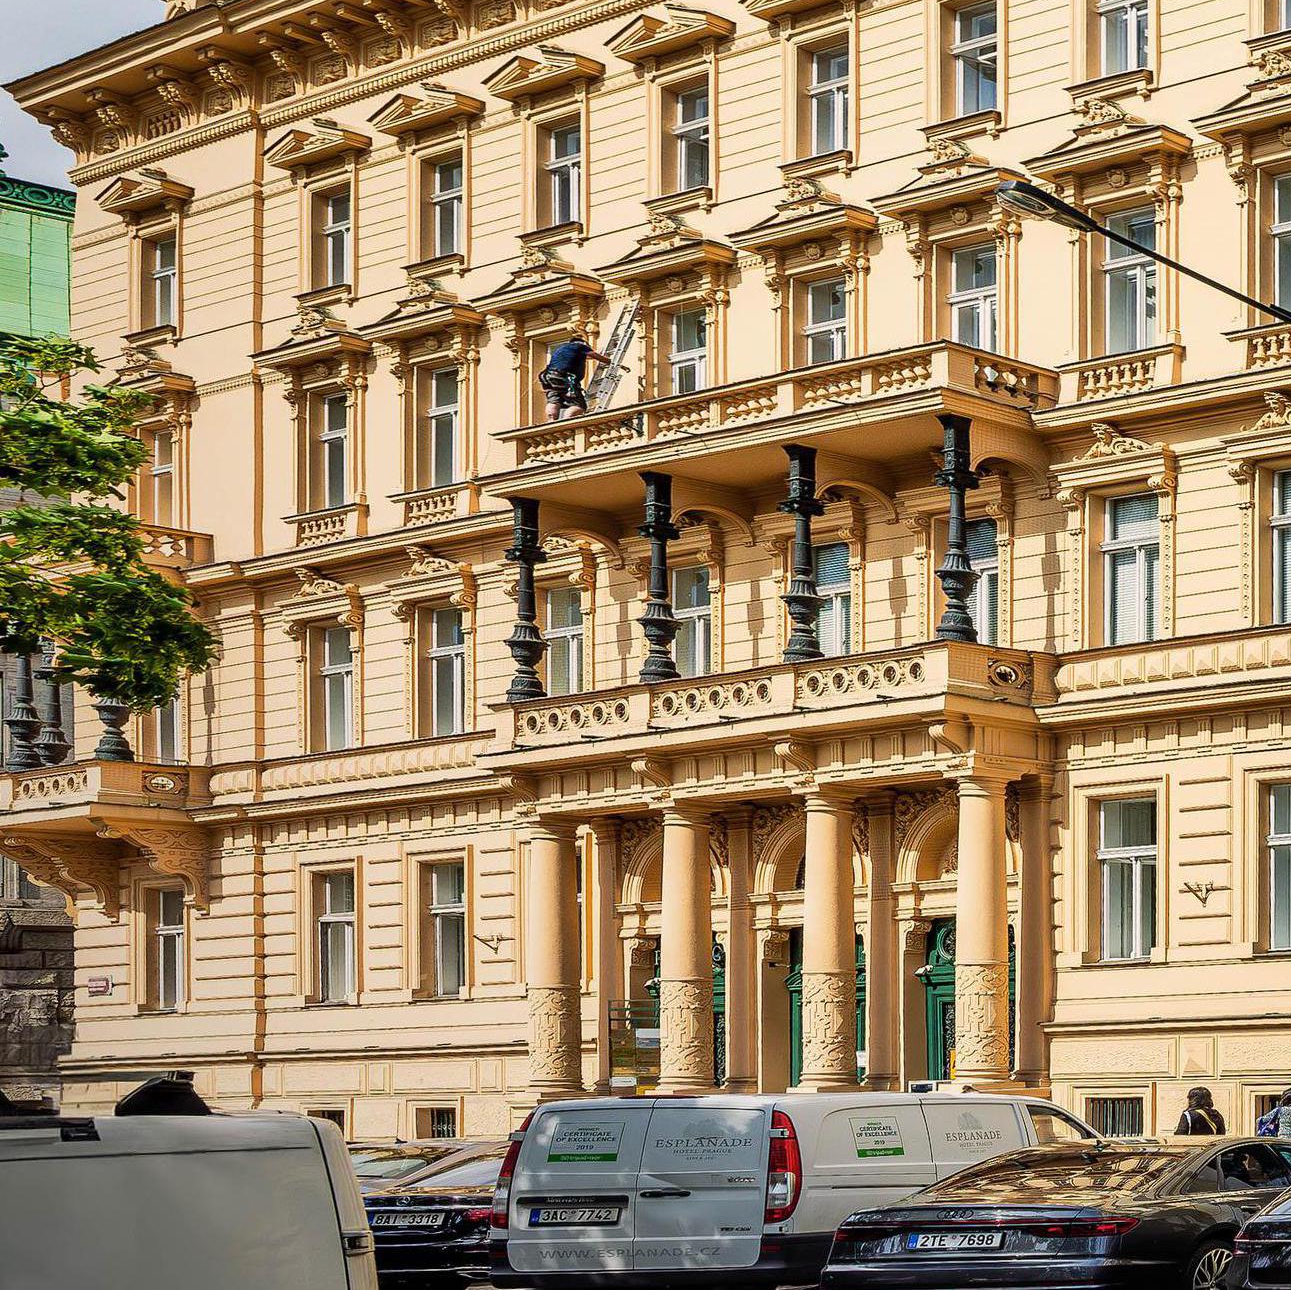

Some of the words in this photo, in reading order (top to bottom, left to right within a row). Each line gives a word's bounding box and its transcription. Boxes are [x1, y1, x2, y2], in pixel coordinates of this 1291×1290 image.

[945, 1130, 1002, 1141] ESPLANADE
[656, 1138, 752, 1148] ESPLANADE
[408, 1214, 439, 1224] 3318
[542, 1210, 567, 1221] 3AC
[577, 1209, 612, 1221] 7742
[920, 1235, 948, 1247] 2TE
[958, 1234, 995, 1246] 7698
[540, 1247, 721, 1259] WWW.ESPLANADE.CZ
